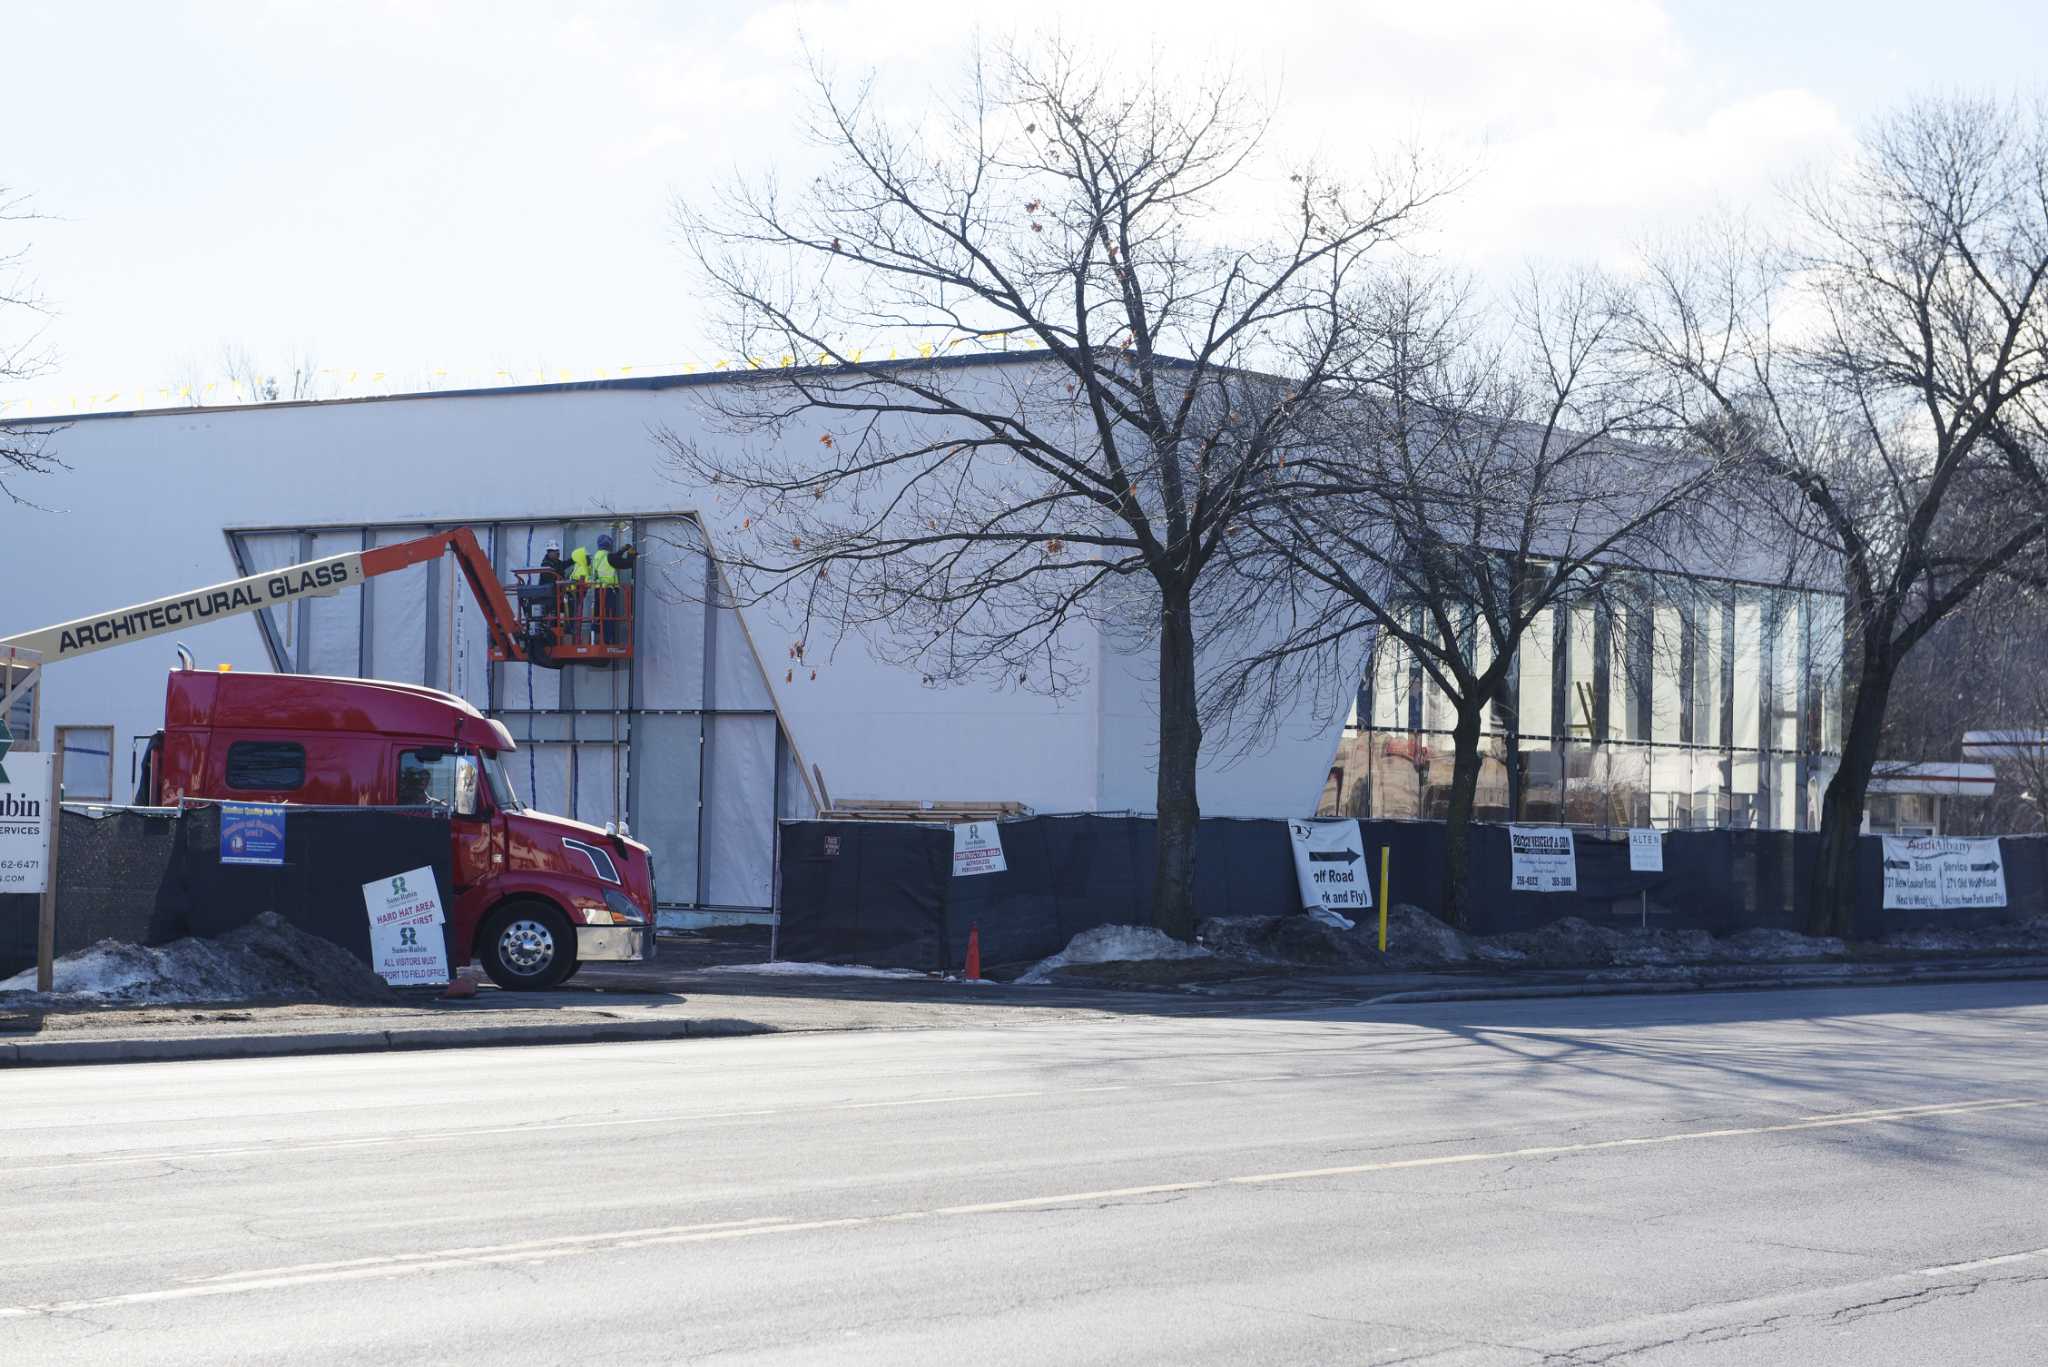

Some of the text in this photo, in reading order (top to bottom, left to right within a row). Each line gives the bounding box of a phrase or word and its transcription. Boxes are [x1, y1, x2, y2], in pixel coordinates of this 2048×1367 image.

[59, 561, 348, 653] ARCHITECTURAL GLASS
[1943, 861, 1968, 872] Service
[1329, 870, 1354, 883] Road
[1333, 891, 1348, 904] and
[1350, 890, 1367, 905] Fly)
[376, 912, 398, 925] HARD
[399, 906, 413, 919] HAT
[415, 900, 435, 914] AREA
[384, 959, 395, 967] ALL
[421, 956, 437, 965] MUST
[380, 967, 447, 980] EPORT TO FIELD OFFICE
